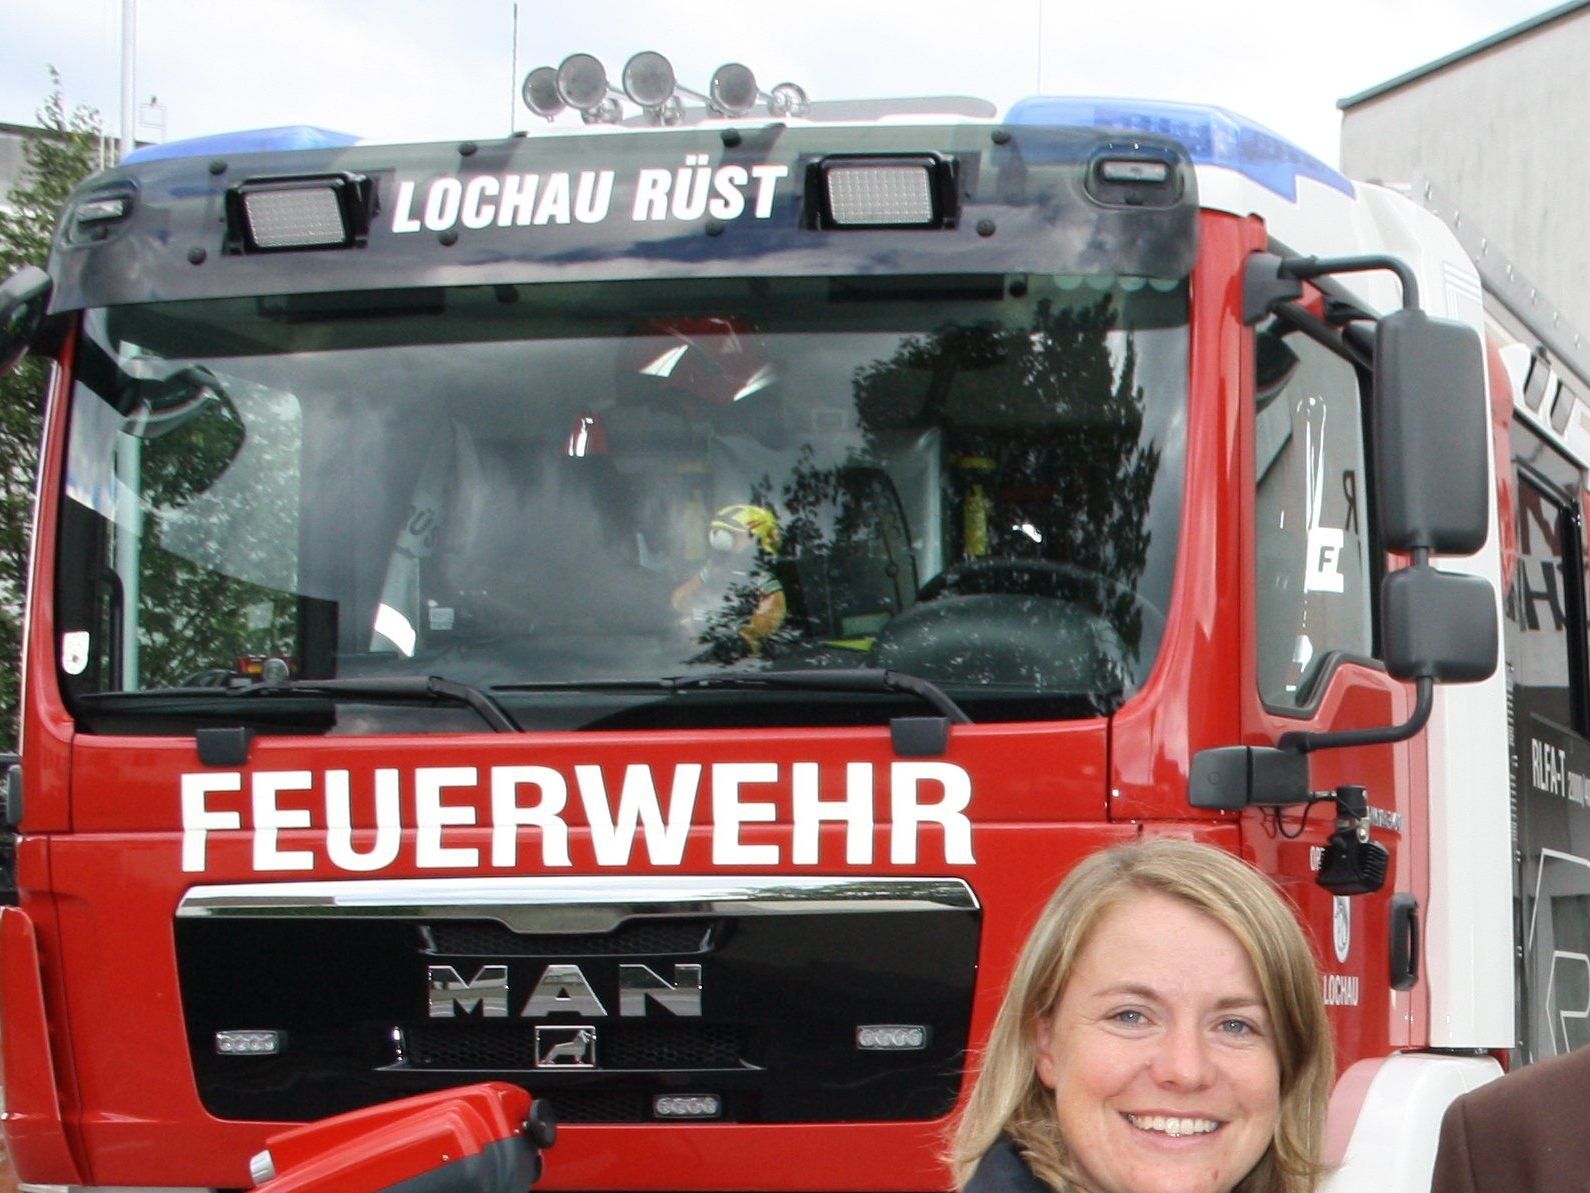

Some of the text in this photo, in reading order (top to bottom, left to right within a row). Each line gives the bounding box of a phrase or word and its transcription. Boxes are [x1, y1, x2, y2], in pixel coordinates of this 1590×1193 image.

[392, 155, 788, 233] LOCHAU RÜST
[1531, 737, 1566, 797] RLFA-T
[180, 761, 978, 873] FEUERWEHR
[428, 964, 703, 1018] MAN
[1323, 974, 1360, 1006] LOCHAU
